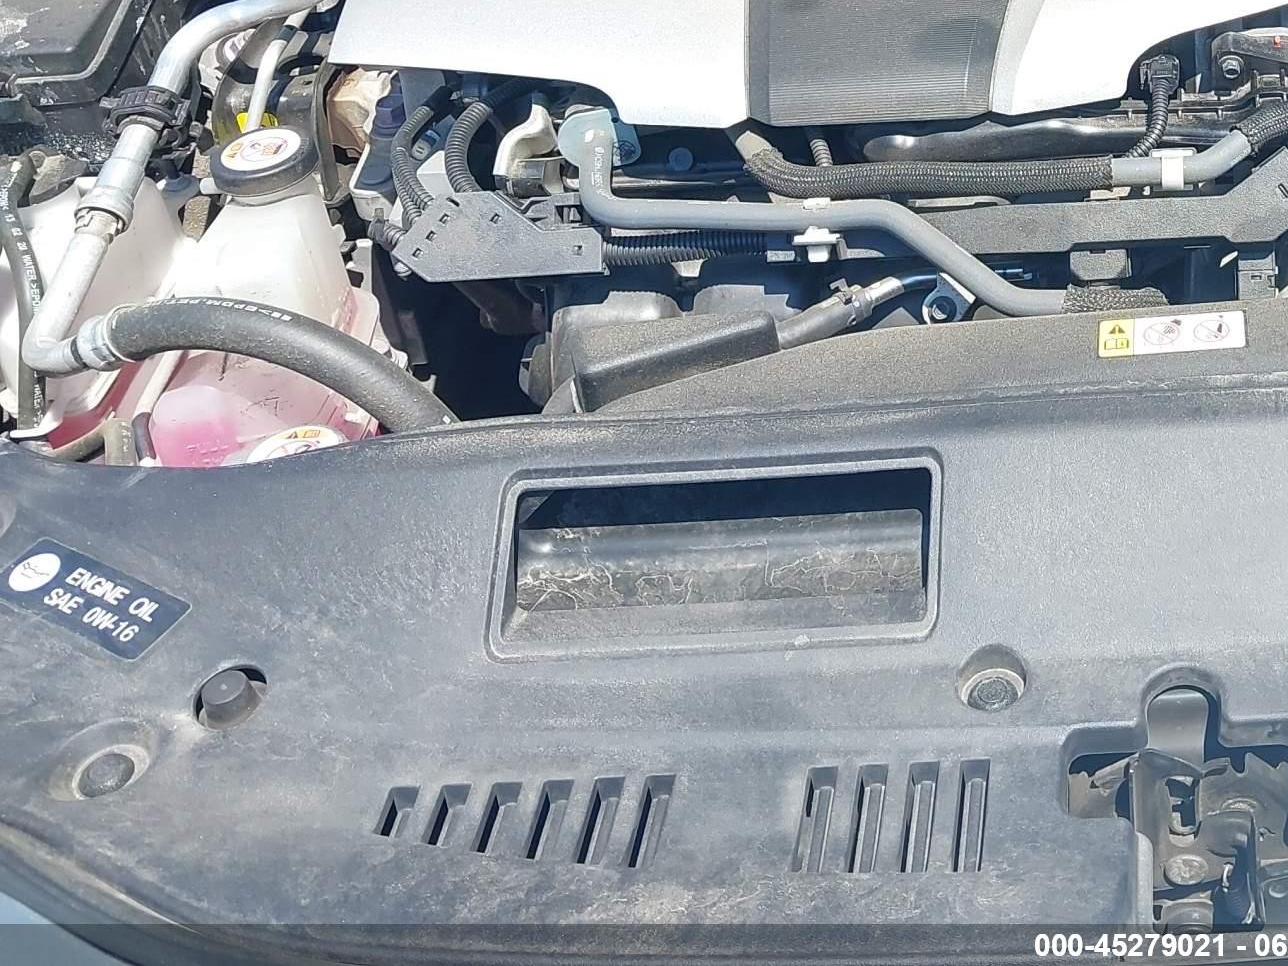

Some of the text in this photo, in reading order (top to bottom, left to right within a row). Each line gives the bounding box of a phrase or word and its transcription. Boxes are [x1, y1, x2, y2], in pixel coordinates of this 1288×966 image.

[22, 254, 37, 282] WATER
[43, 588, 139, 642] SAE 0W-16
[65, 567, 159, 622] ENGINE OIL
